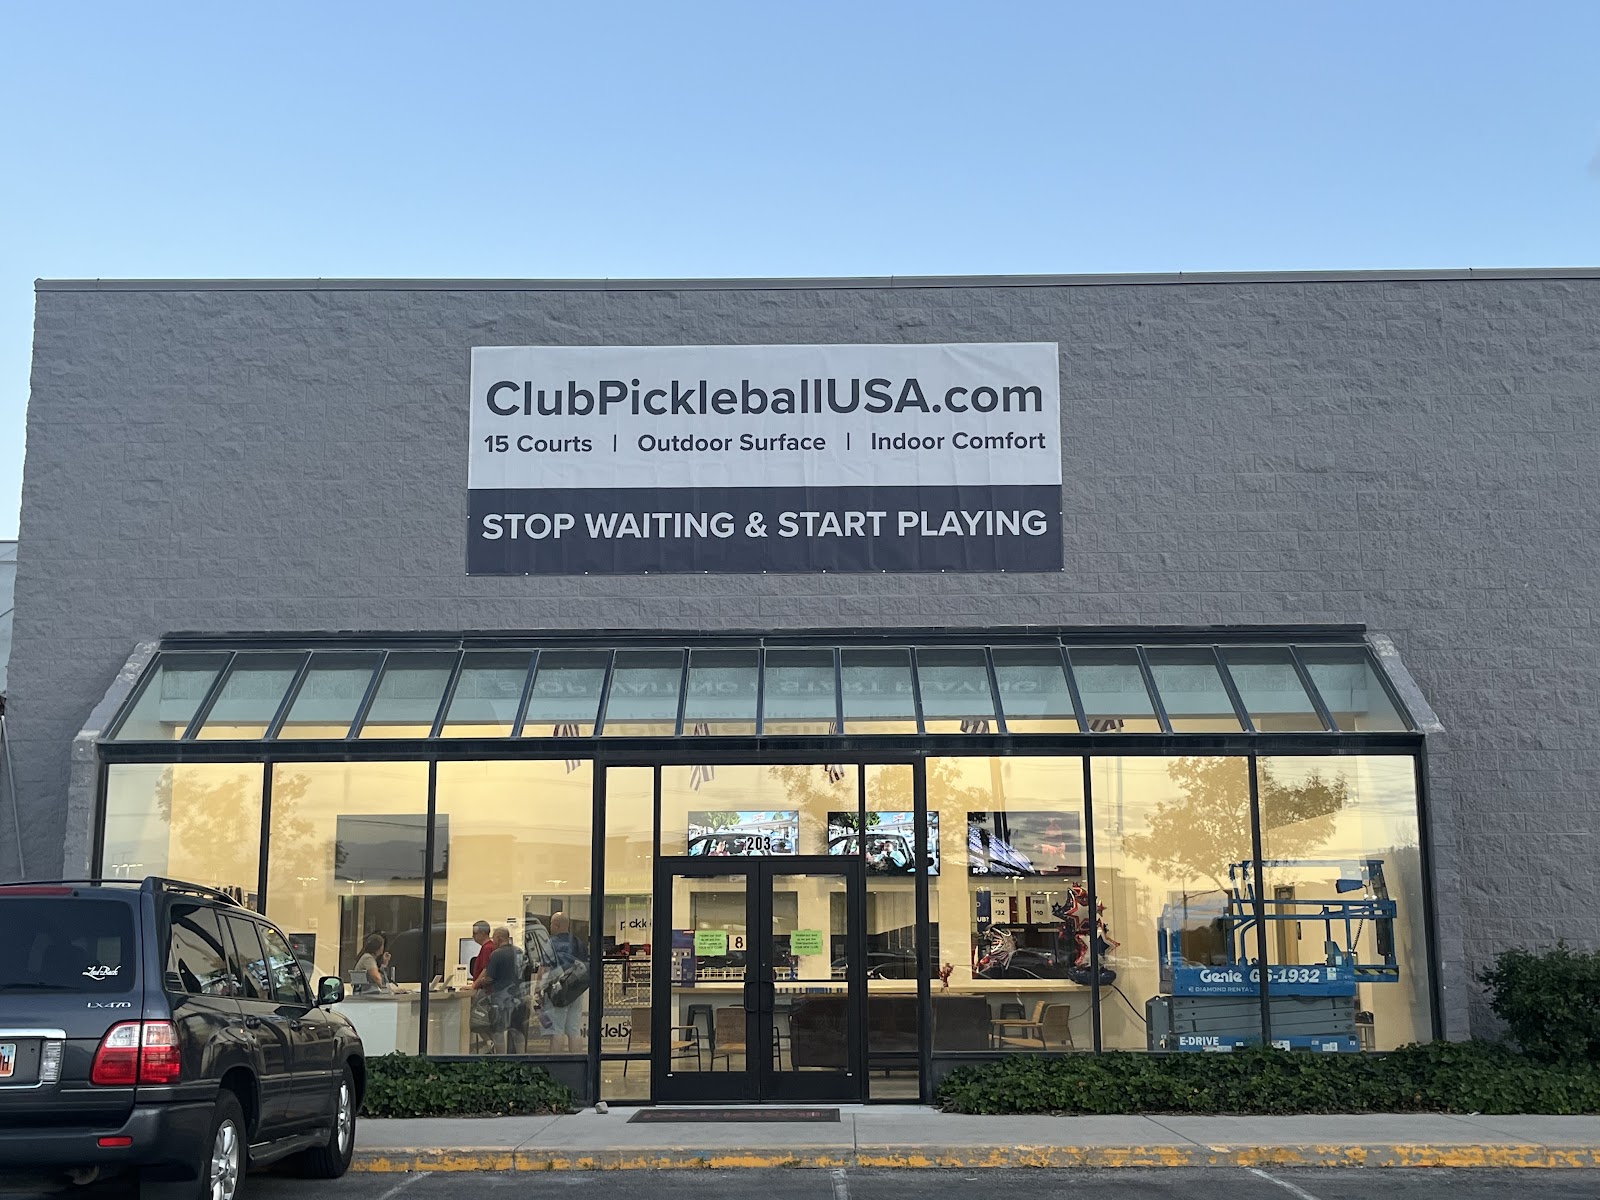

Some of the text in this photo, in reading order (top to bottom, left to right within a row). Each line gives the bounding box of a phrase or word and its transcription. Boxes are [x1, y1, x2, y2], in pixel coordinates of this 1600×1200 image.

[486, 378, 1043, 416] ClubPickleballUSA.com
[484, 435, 509, 452] 15
[516, 434, 593, 452] Courts
[637, 433, 733, 452] Outdoor
[739, 433, 826, 451] Surface
[871, 432, 945, 450] Indoor
[952, 431, 1046, 450] Comfort
[481, 510, 1047, 540] STOP WAITING & START PLAYING
[747, 836, 771, 851] 203
[1199, 969, 1243, 983] Genie
[1180, 1036, 1219, 1046] E-DRIVE
